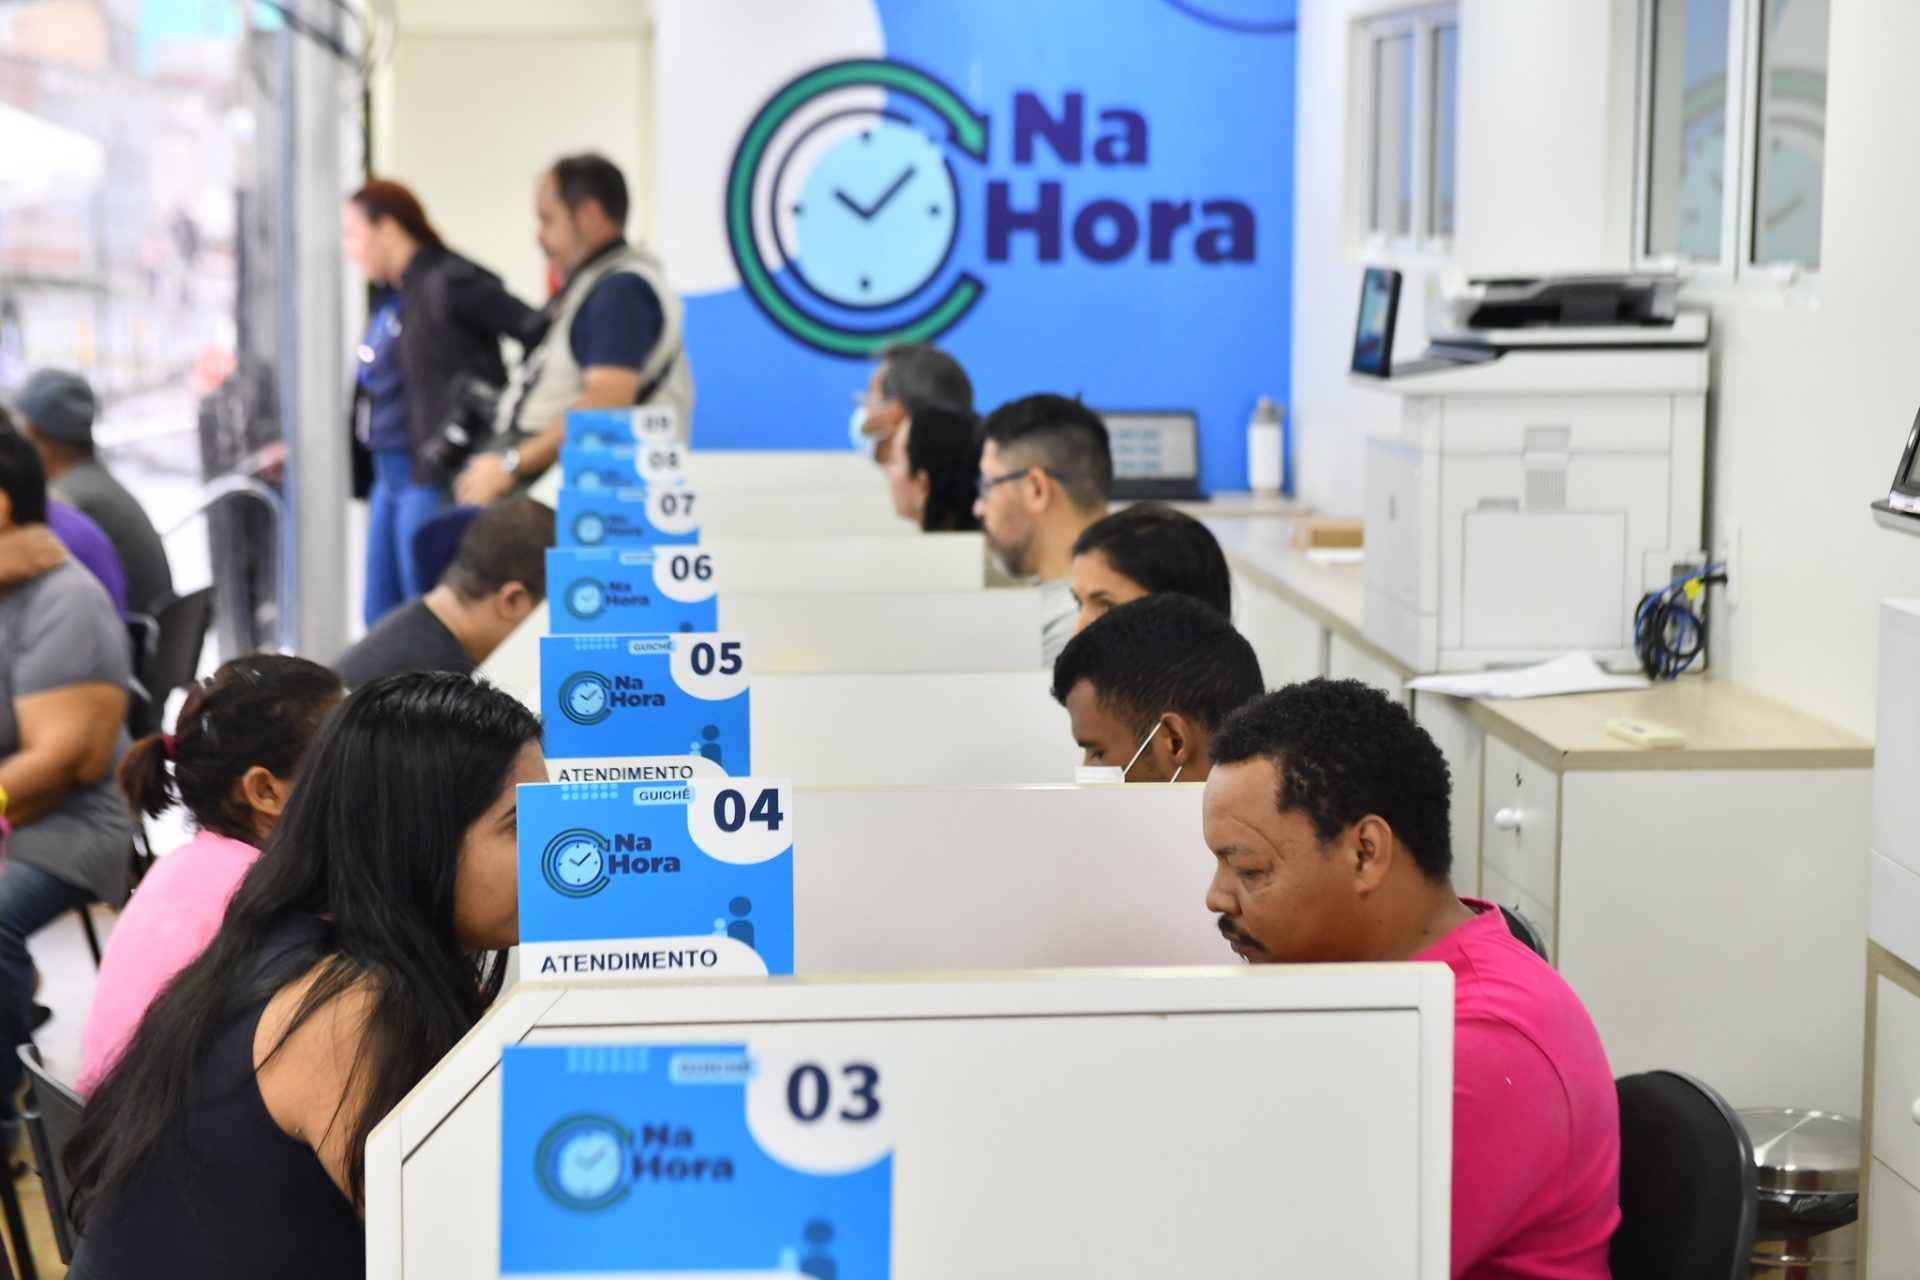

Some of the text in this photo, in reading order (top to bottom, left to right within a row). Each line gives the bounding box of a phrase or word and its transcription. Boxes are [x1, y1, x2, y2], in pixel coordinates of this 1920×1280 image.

[1013, 92, 1147, 165] Na
[986, 181, 1256, 263] Hora
[660, 493, 695, 516] 07
[671, 555, 712, 580] 06
[691, 641, 743, 676] 05
[614, 676, 644, 690] Na
[610, 692, 666, 707] Hora
[559, 765, 694, 783] ATENDIMENTO
[639, 788, 784, 833] GUICHÊ 04
[614, 833, 652, 852] Na
[608, 853, 681, 875] Hora
[541, 949, 718, 974] ATENDIMENTO
[786, 1063, 882, 1123] 03
[642, 1124, 694, 1150] Na
[632, 1156, 736, 1183] Hora
